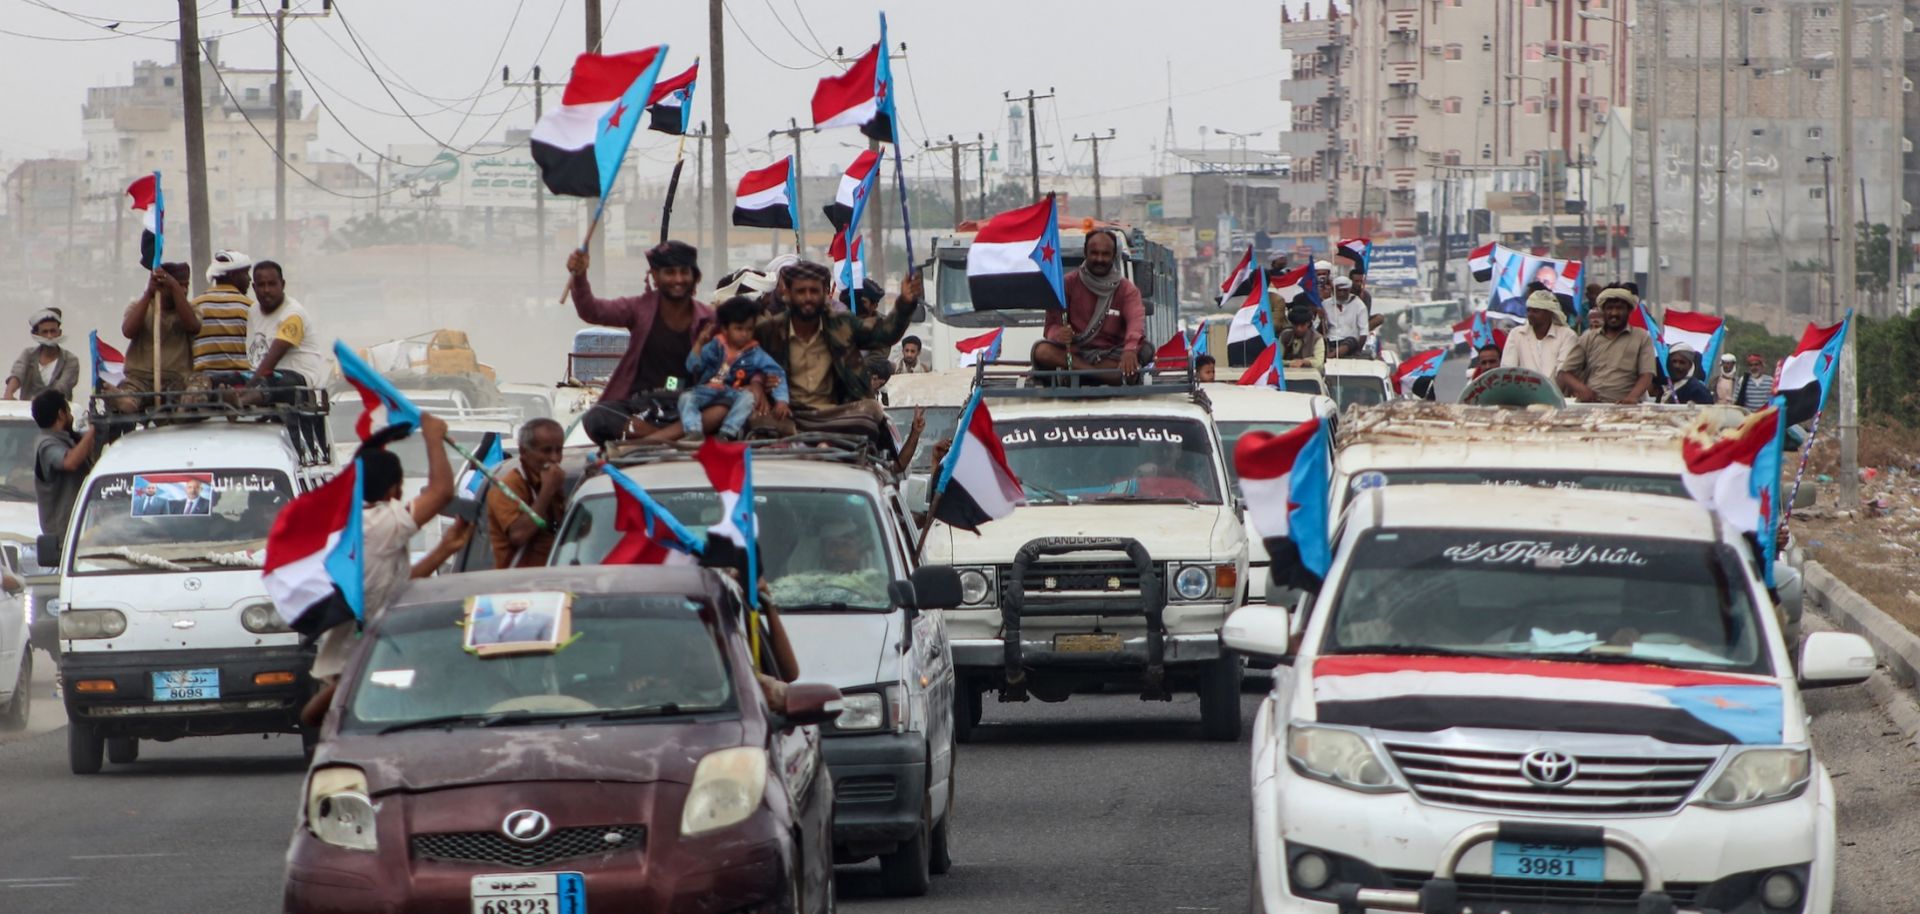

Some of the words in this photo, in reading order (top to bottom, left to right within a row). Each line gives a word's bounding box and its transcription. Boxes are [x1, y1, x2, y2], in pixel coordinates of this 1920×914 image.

[1002, 428, 1037, 444] الله
[170, 688, 203, 699] 8098
[1518, 857, 1576, 876] 3981
